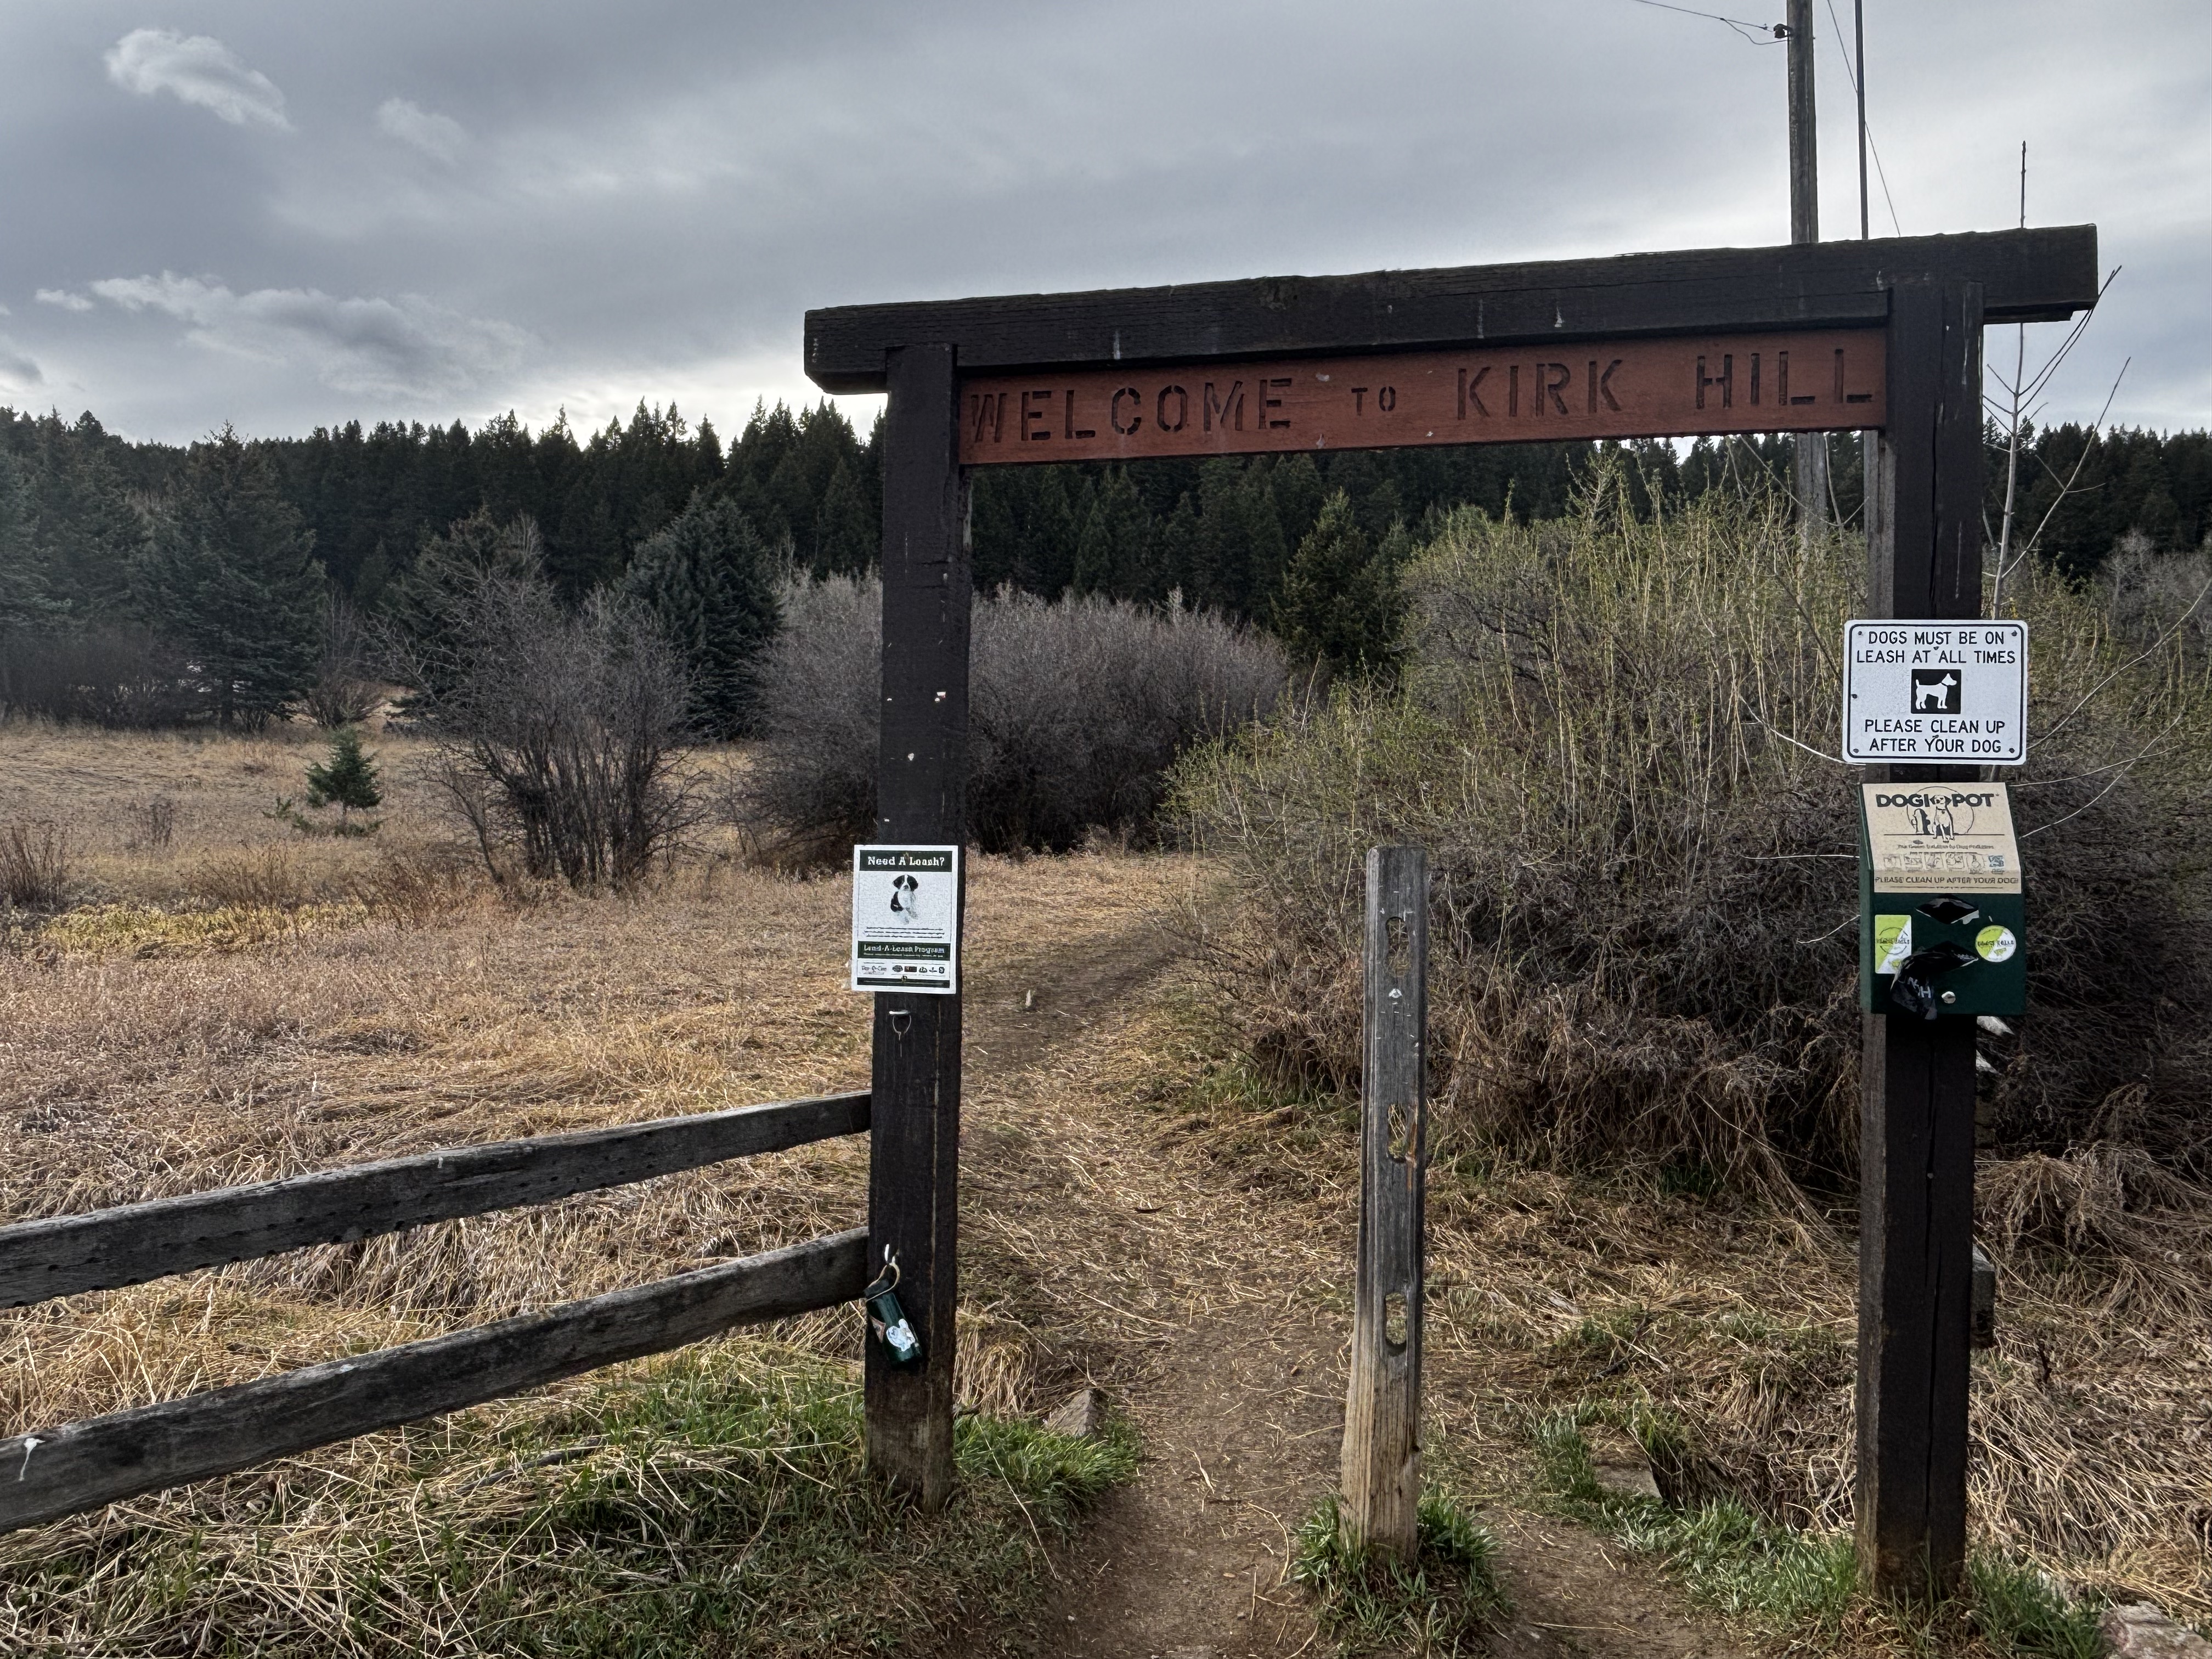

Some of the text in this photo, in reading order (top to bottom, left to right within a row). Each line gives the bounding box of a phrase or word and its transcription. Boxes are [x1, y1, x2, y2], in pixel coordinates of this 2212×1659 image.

[970, 348, 1873, 444] WELCOME TO KIRK HILL
[1868, 631, 2005, 645] DOGS MUST BE ON
[1857, 650, 2016, 664] LEASH AT ALL TIMES
[1865, 719, 2006, 734] PLEASE CLEAN UP
[1869, 738, 2001, 753] AFTER YOUR DOG
[867, 856, 945, 866] Need A Leash?
